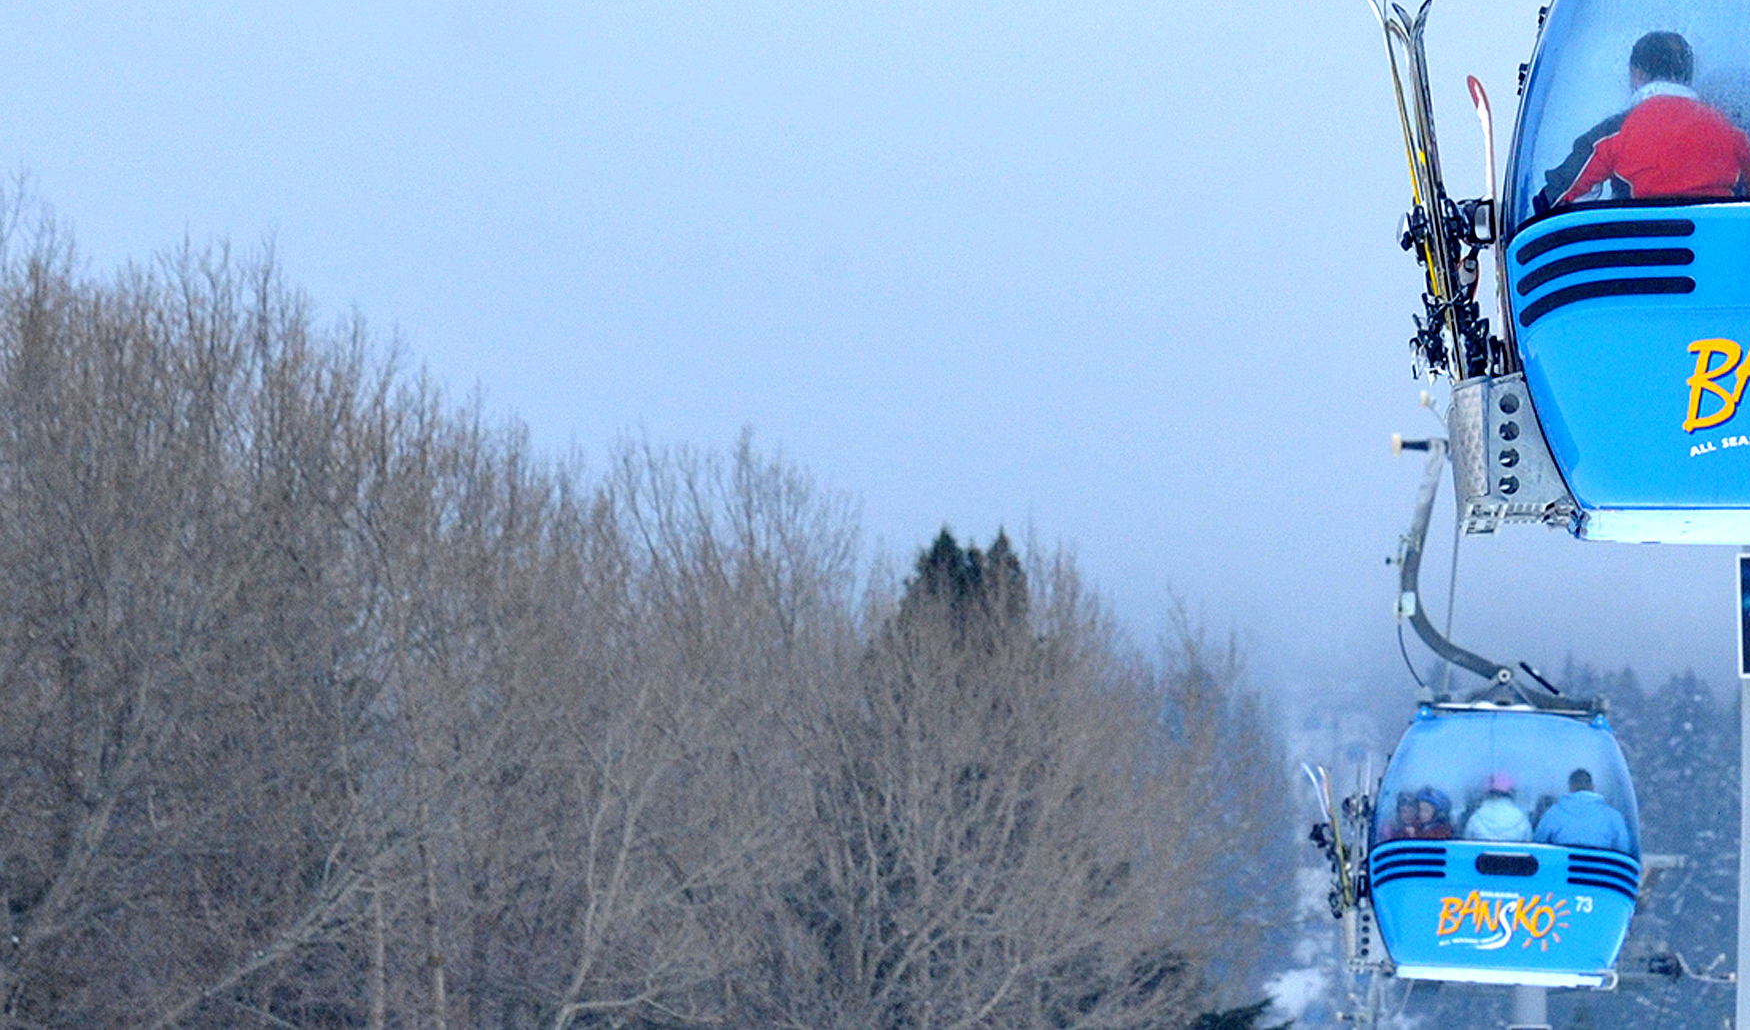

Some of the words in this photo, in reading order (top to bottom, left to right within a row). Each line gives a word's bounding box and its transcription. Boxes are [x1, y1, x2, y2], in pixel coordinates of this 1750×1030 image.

[1690, 441, 1716, 457] ALL
[1575, 895, 1594, 913] 73
[1437, 889, 1556, 950] BANSKO
